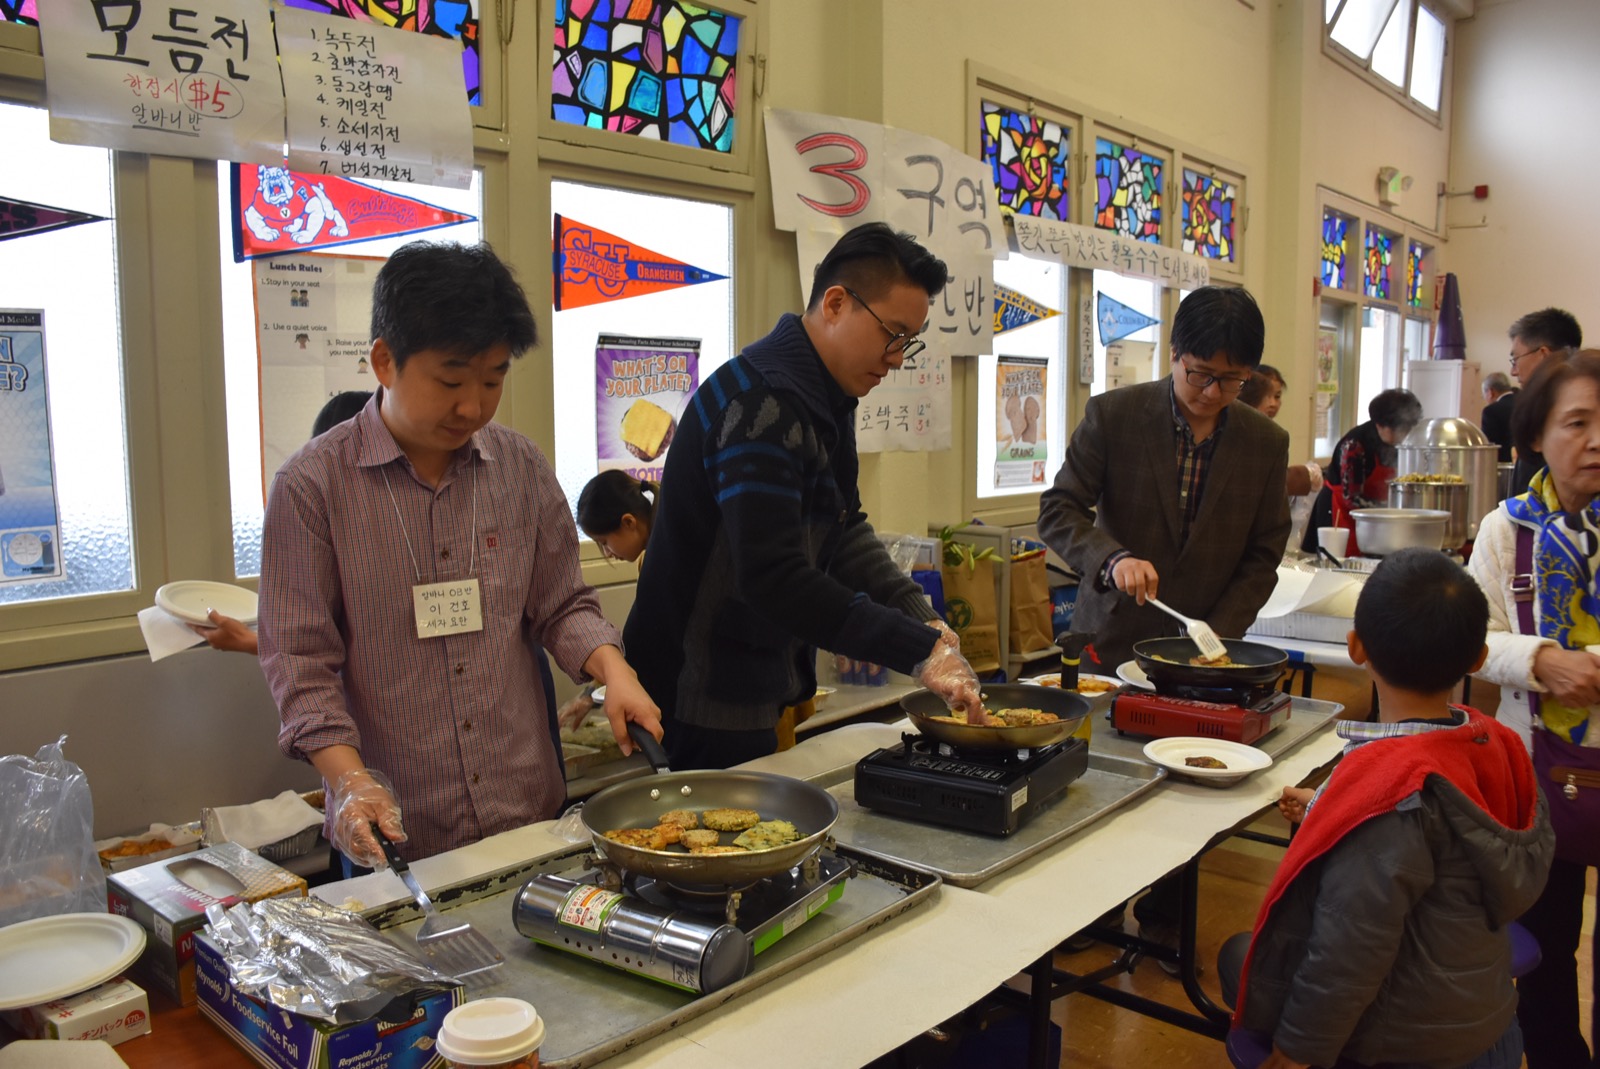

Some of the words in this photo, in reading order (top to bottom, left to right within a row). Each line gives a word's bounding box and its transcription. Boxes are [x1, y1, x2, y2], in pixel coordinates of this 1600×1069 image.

[86, 0, 250, 81] 모듬전
[325, 28, 376, 59] 녹두전
[327, 52, 402, 84] 호박감자전
[336, 97, 386, 120] 케일전
[337, 117, 400, 143] 소세지전
[336, 140, 386, 160] 생선전
[341, 161, 415, 182] 버섯게살전
[270, 262, 297, 271] Lunch
[299, 264, 322, 273] Rules
[569, 251, 621, 279] SYRACUSE
[290, 280, 305, 288] your
[273, 323, 285, 331] Use
[292, 324, 309, 333] quiet
[612, 355, 667, 378] WHAT'S
[669, 356, 687, 373] ON
[606, 378, 642, 397] YOUR
[644, 373, 692, 394] PLATE?
[861, 404, 908, 432] 호박죽
[1010, 447, 1035, 459] GRAINS
[197, 964, 222, 995] Reynolds
[232, 993, 281, 1043] Foodservice
[282, 1034, 298, 1060] Foil
[338, 1050, 373, 1068] Reynolds
